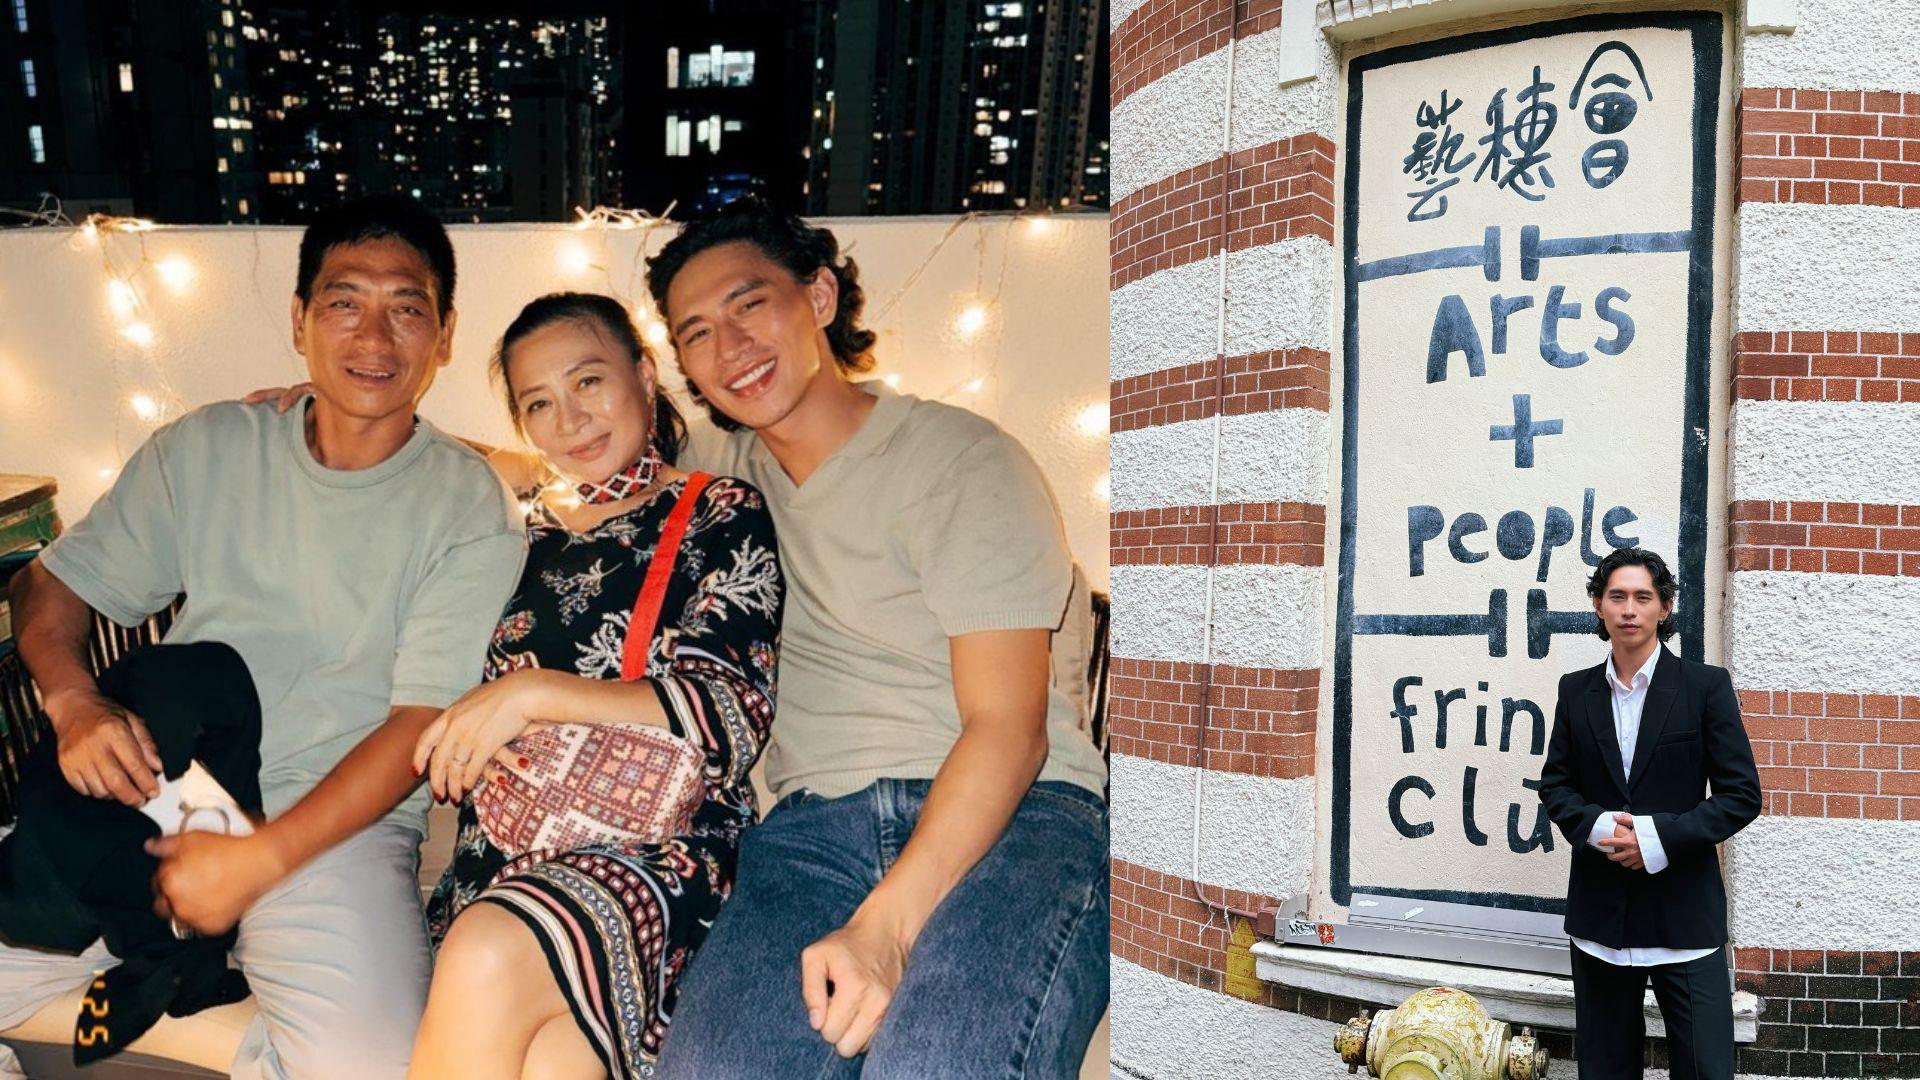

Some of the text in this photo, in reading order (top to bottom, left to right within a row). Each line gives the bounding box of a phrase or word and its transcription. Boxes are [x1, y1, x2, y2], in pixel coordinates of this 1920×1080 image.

[1403, 41, 1653, 222] 藝穗會
[1426, 285, 1635, 384] Arts
[1390, 676, 1546, 755] frin
[1388, 766, 1554, 854] clu
